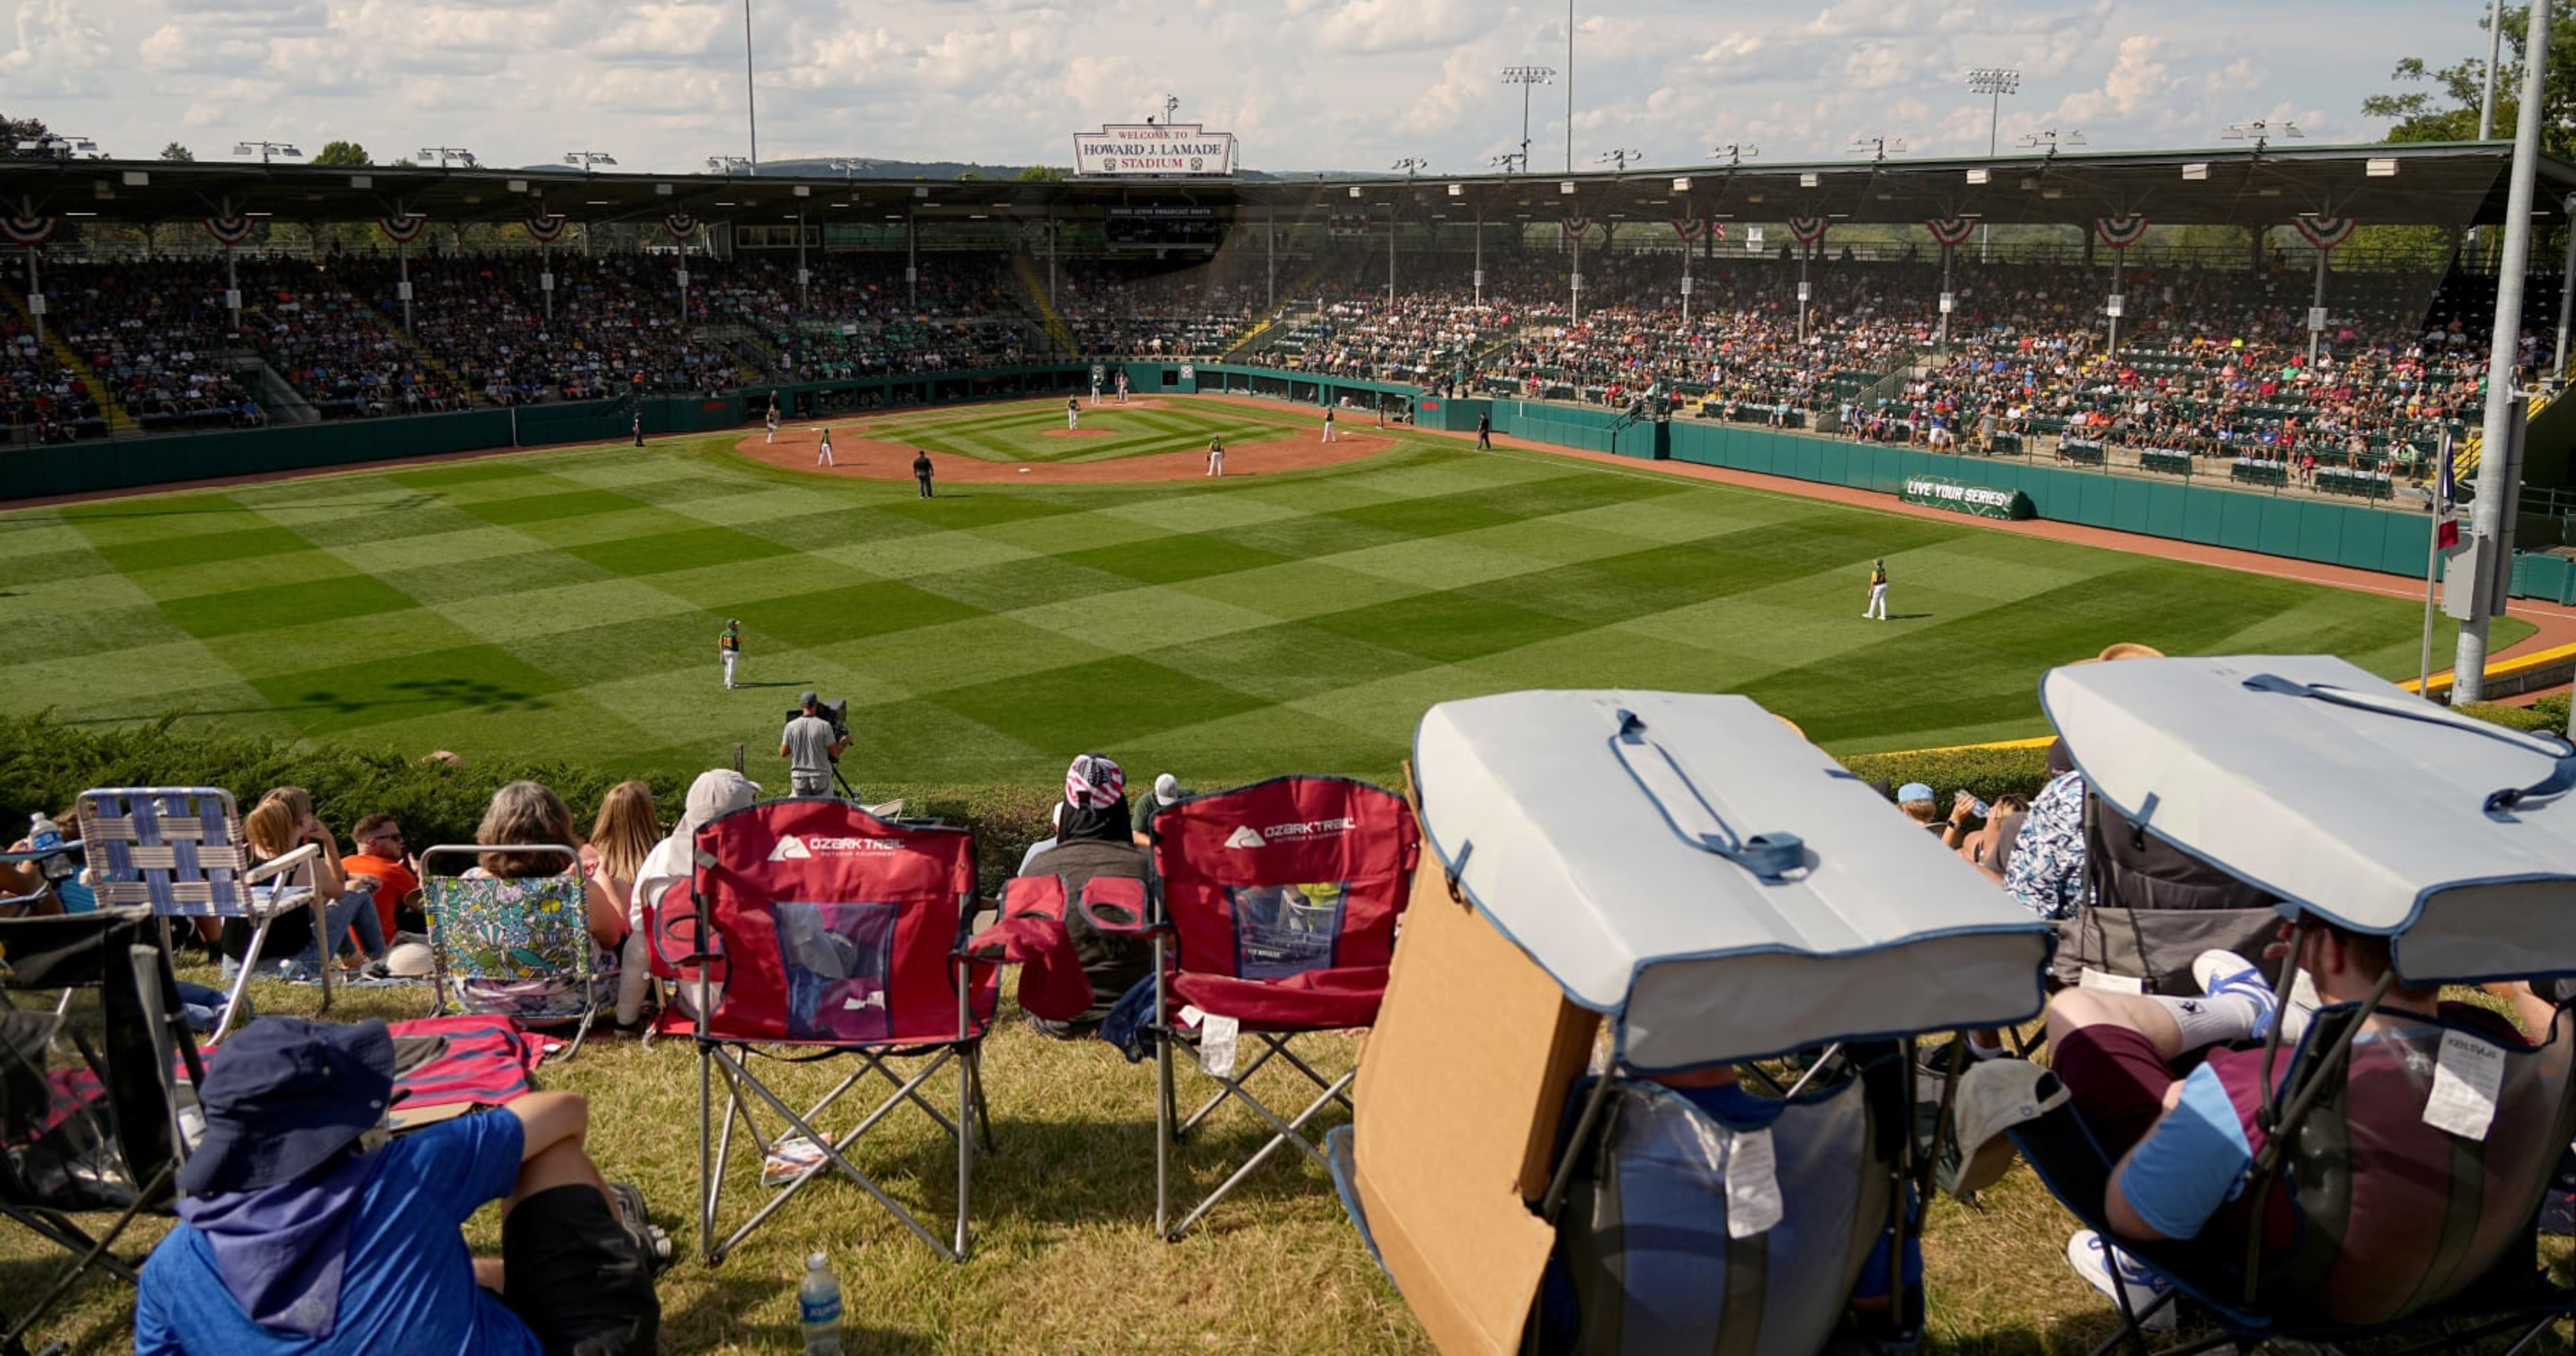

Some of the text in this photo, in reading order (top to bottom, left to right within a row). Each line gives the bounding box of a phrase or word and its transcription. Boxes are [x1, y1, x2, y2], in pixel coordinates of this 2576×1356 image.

[1119, 132, 1171, 140] WELCOME
[1085, 144, 1222, 155] HOWARD J. LAMADE
[1122, 159, 1182, 168] STADIUM
[1908, 481, 2005, 506] LIVE YOUR SERIES
